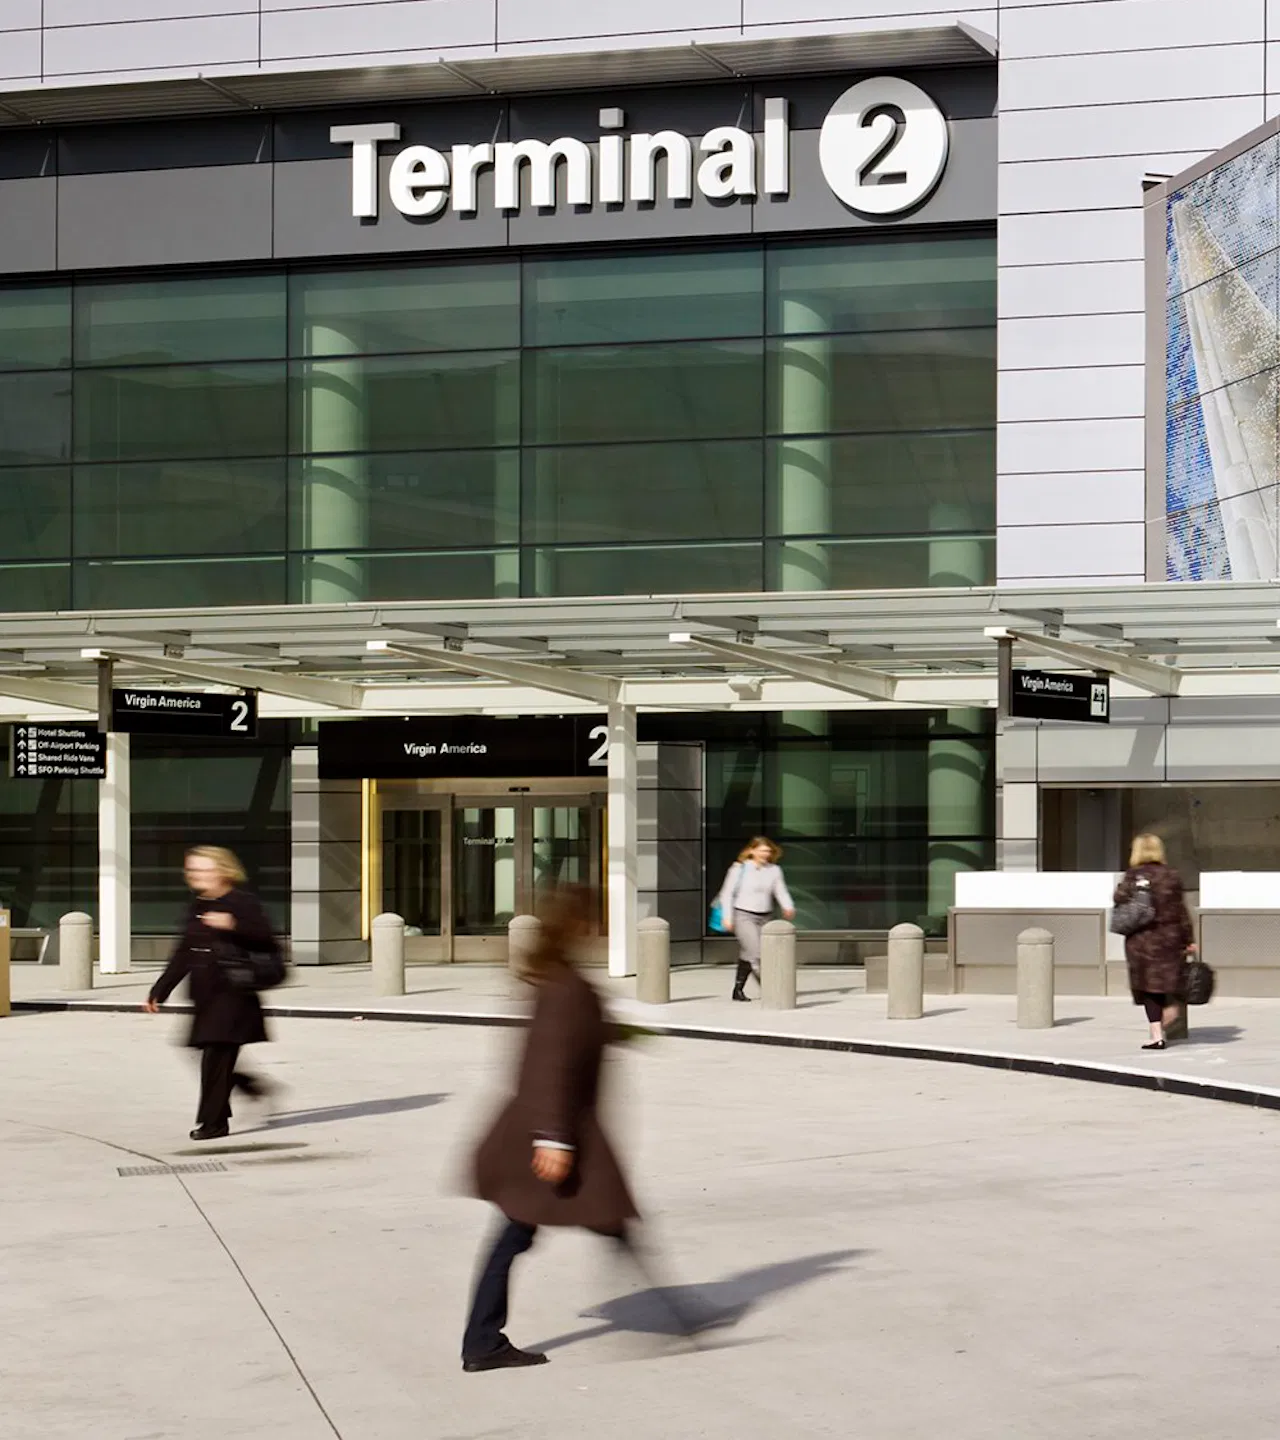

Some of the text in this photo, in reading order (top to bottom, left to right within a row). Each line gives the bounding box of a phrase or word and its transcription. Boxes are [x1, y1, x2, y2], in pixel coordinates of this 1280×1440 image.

[330, 97, 789, 218] Terminal
[1021, 675, 1074, 692] Virgin America
[125, 694, 201, 710] Virgin America
[230, 701, 249, 732] 2
[38, 728, 86, 738] Hotel Shuttles
[75, 742, 100, 752] Parking
[404, 742, 487, 757] Virgin America
[588, 725, 609, 766] 2
[38, 753, 62, 762] Shared
[63, 754, 78, 762] Ride
[54, 766, 79, 775] Parking
[463, 836, 495, 846] Terminal
